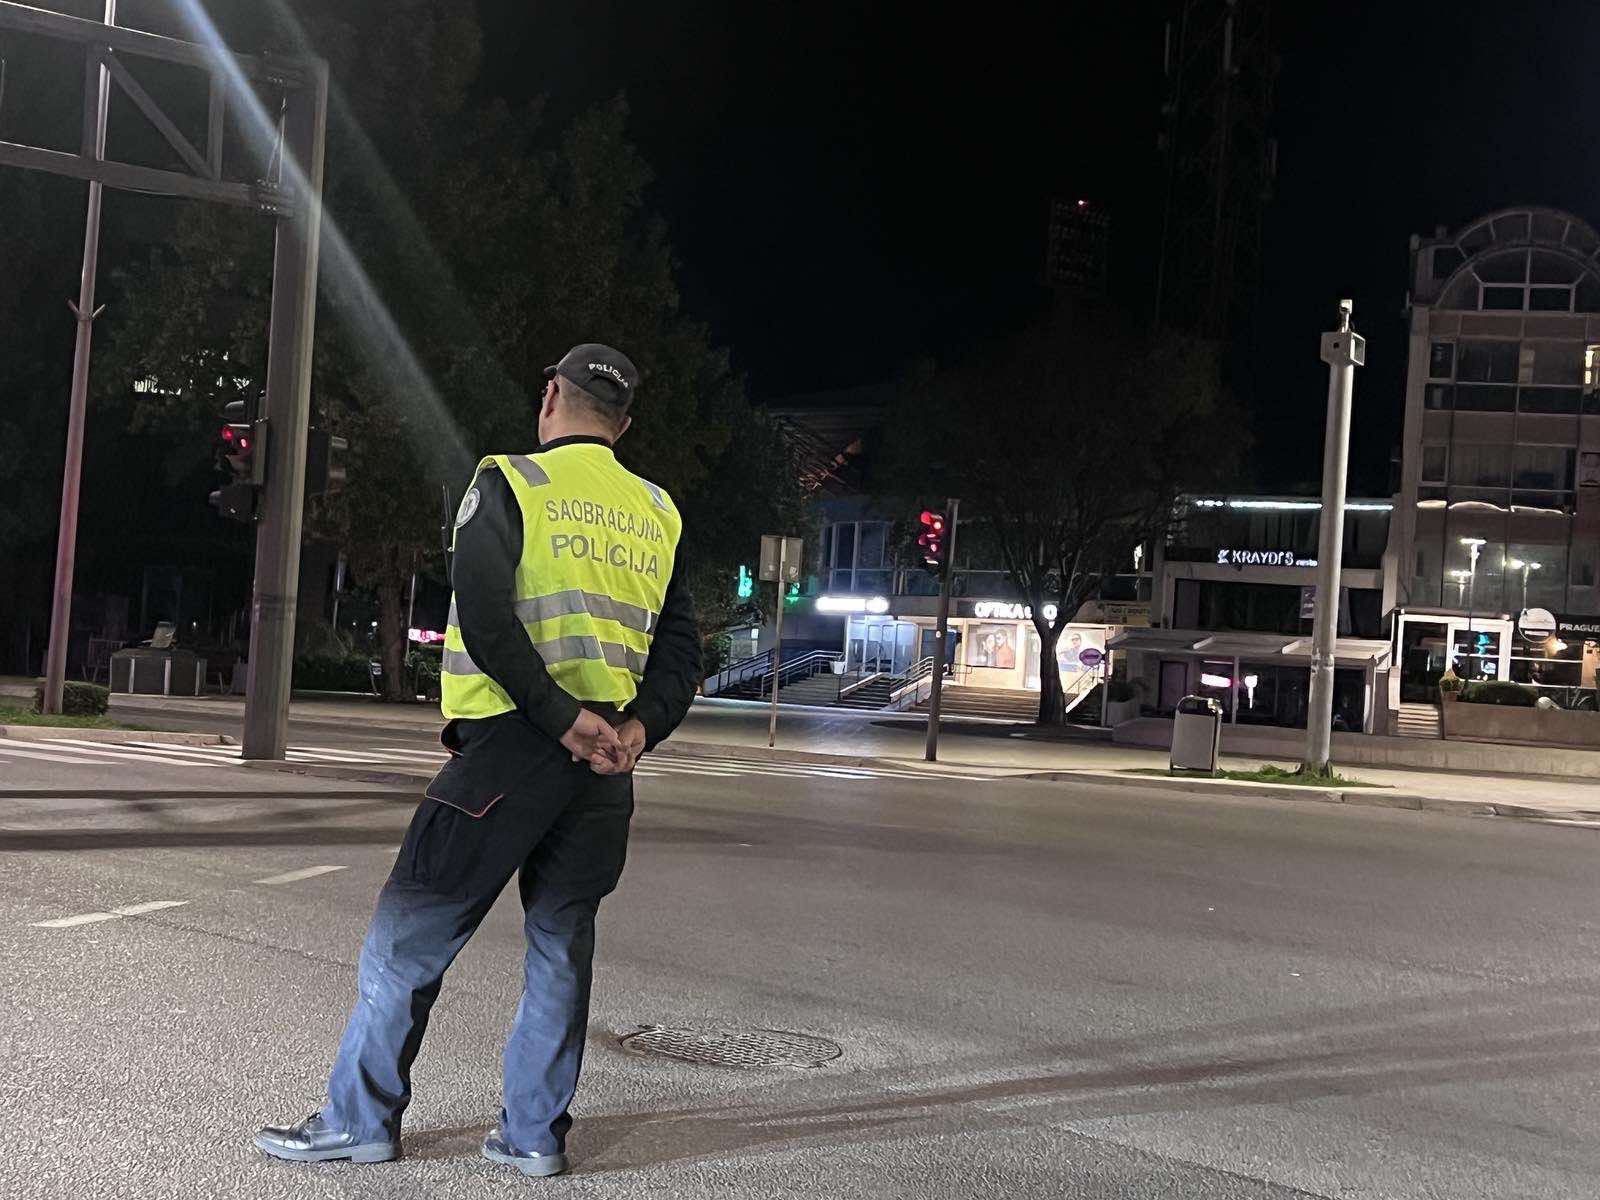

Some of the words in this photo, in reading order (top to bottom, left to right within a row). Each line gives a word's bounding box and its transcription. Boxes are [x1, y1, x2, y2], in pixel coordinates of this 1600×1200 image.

[589, 363, 629, 388] POLICIJA
[545, 499, 663, 543] SAOBRAĆAJNA
[551, 534, 659, 579] POLICIJA
